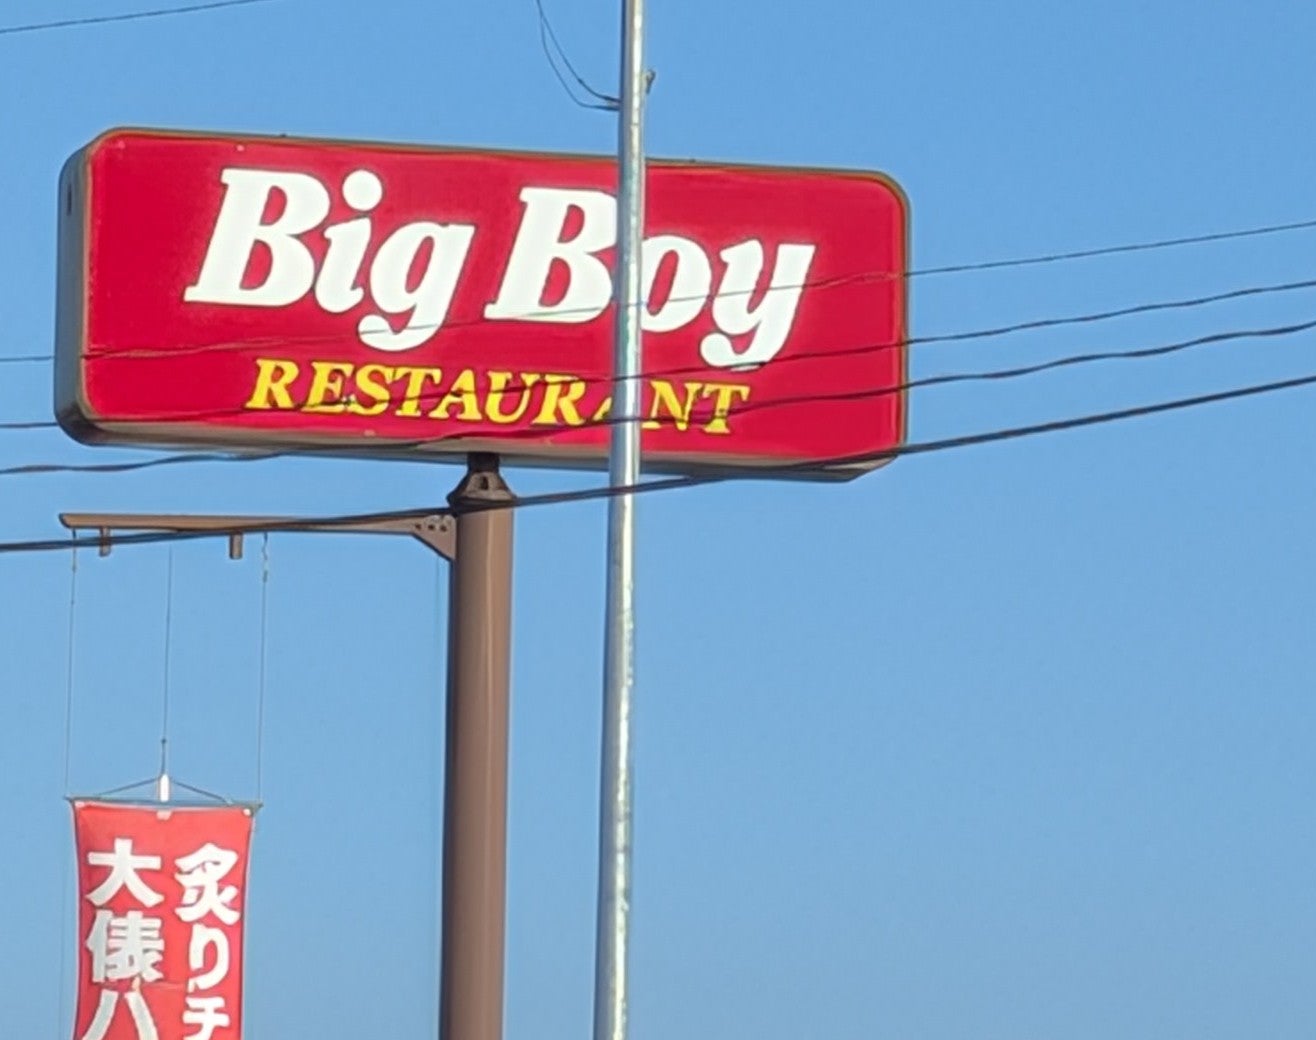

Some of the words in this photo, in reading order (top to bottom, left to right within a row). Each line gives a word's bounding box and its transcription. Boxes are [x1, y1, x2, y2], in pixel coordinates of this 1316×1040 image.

[184, 168, 475, 351] Big
[486, 187, 815, 370] Boy
[245, 358, 751, 436] RESTAURNT
